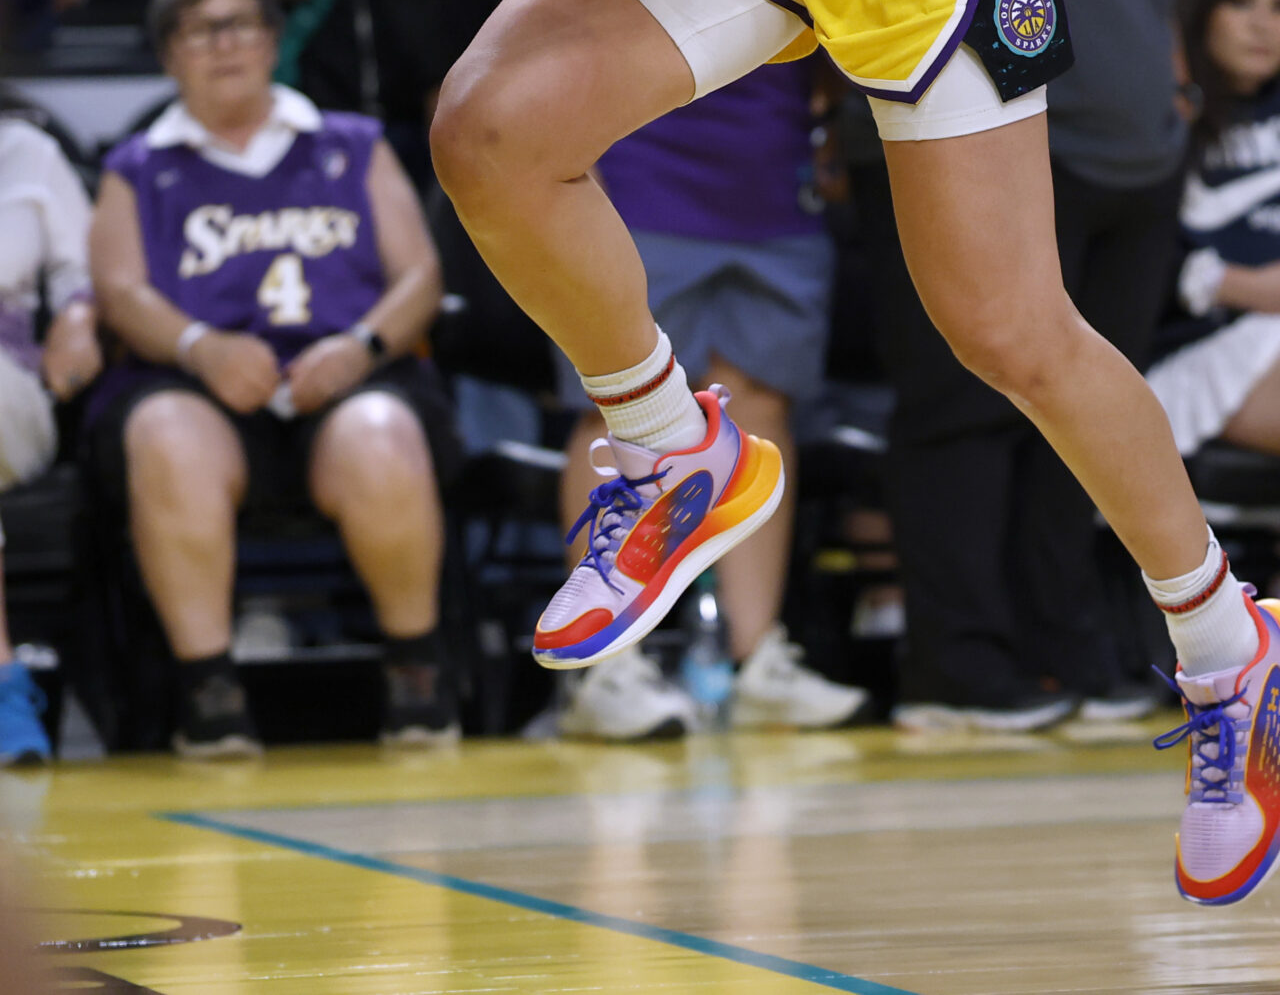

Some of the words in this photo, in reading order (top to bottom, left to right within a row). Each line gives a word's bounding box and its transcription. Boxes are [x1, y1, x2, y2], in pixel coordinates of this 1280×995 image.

[1001, 2, 1009, 29] LOS
[1015, 24, 1052, 50] SPARKS
[257, 254, 312, 326] 4
